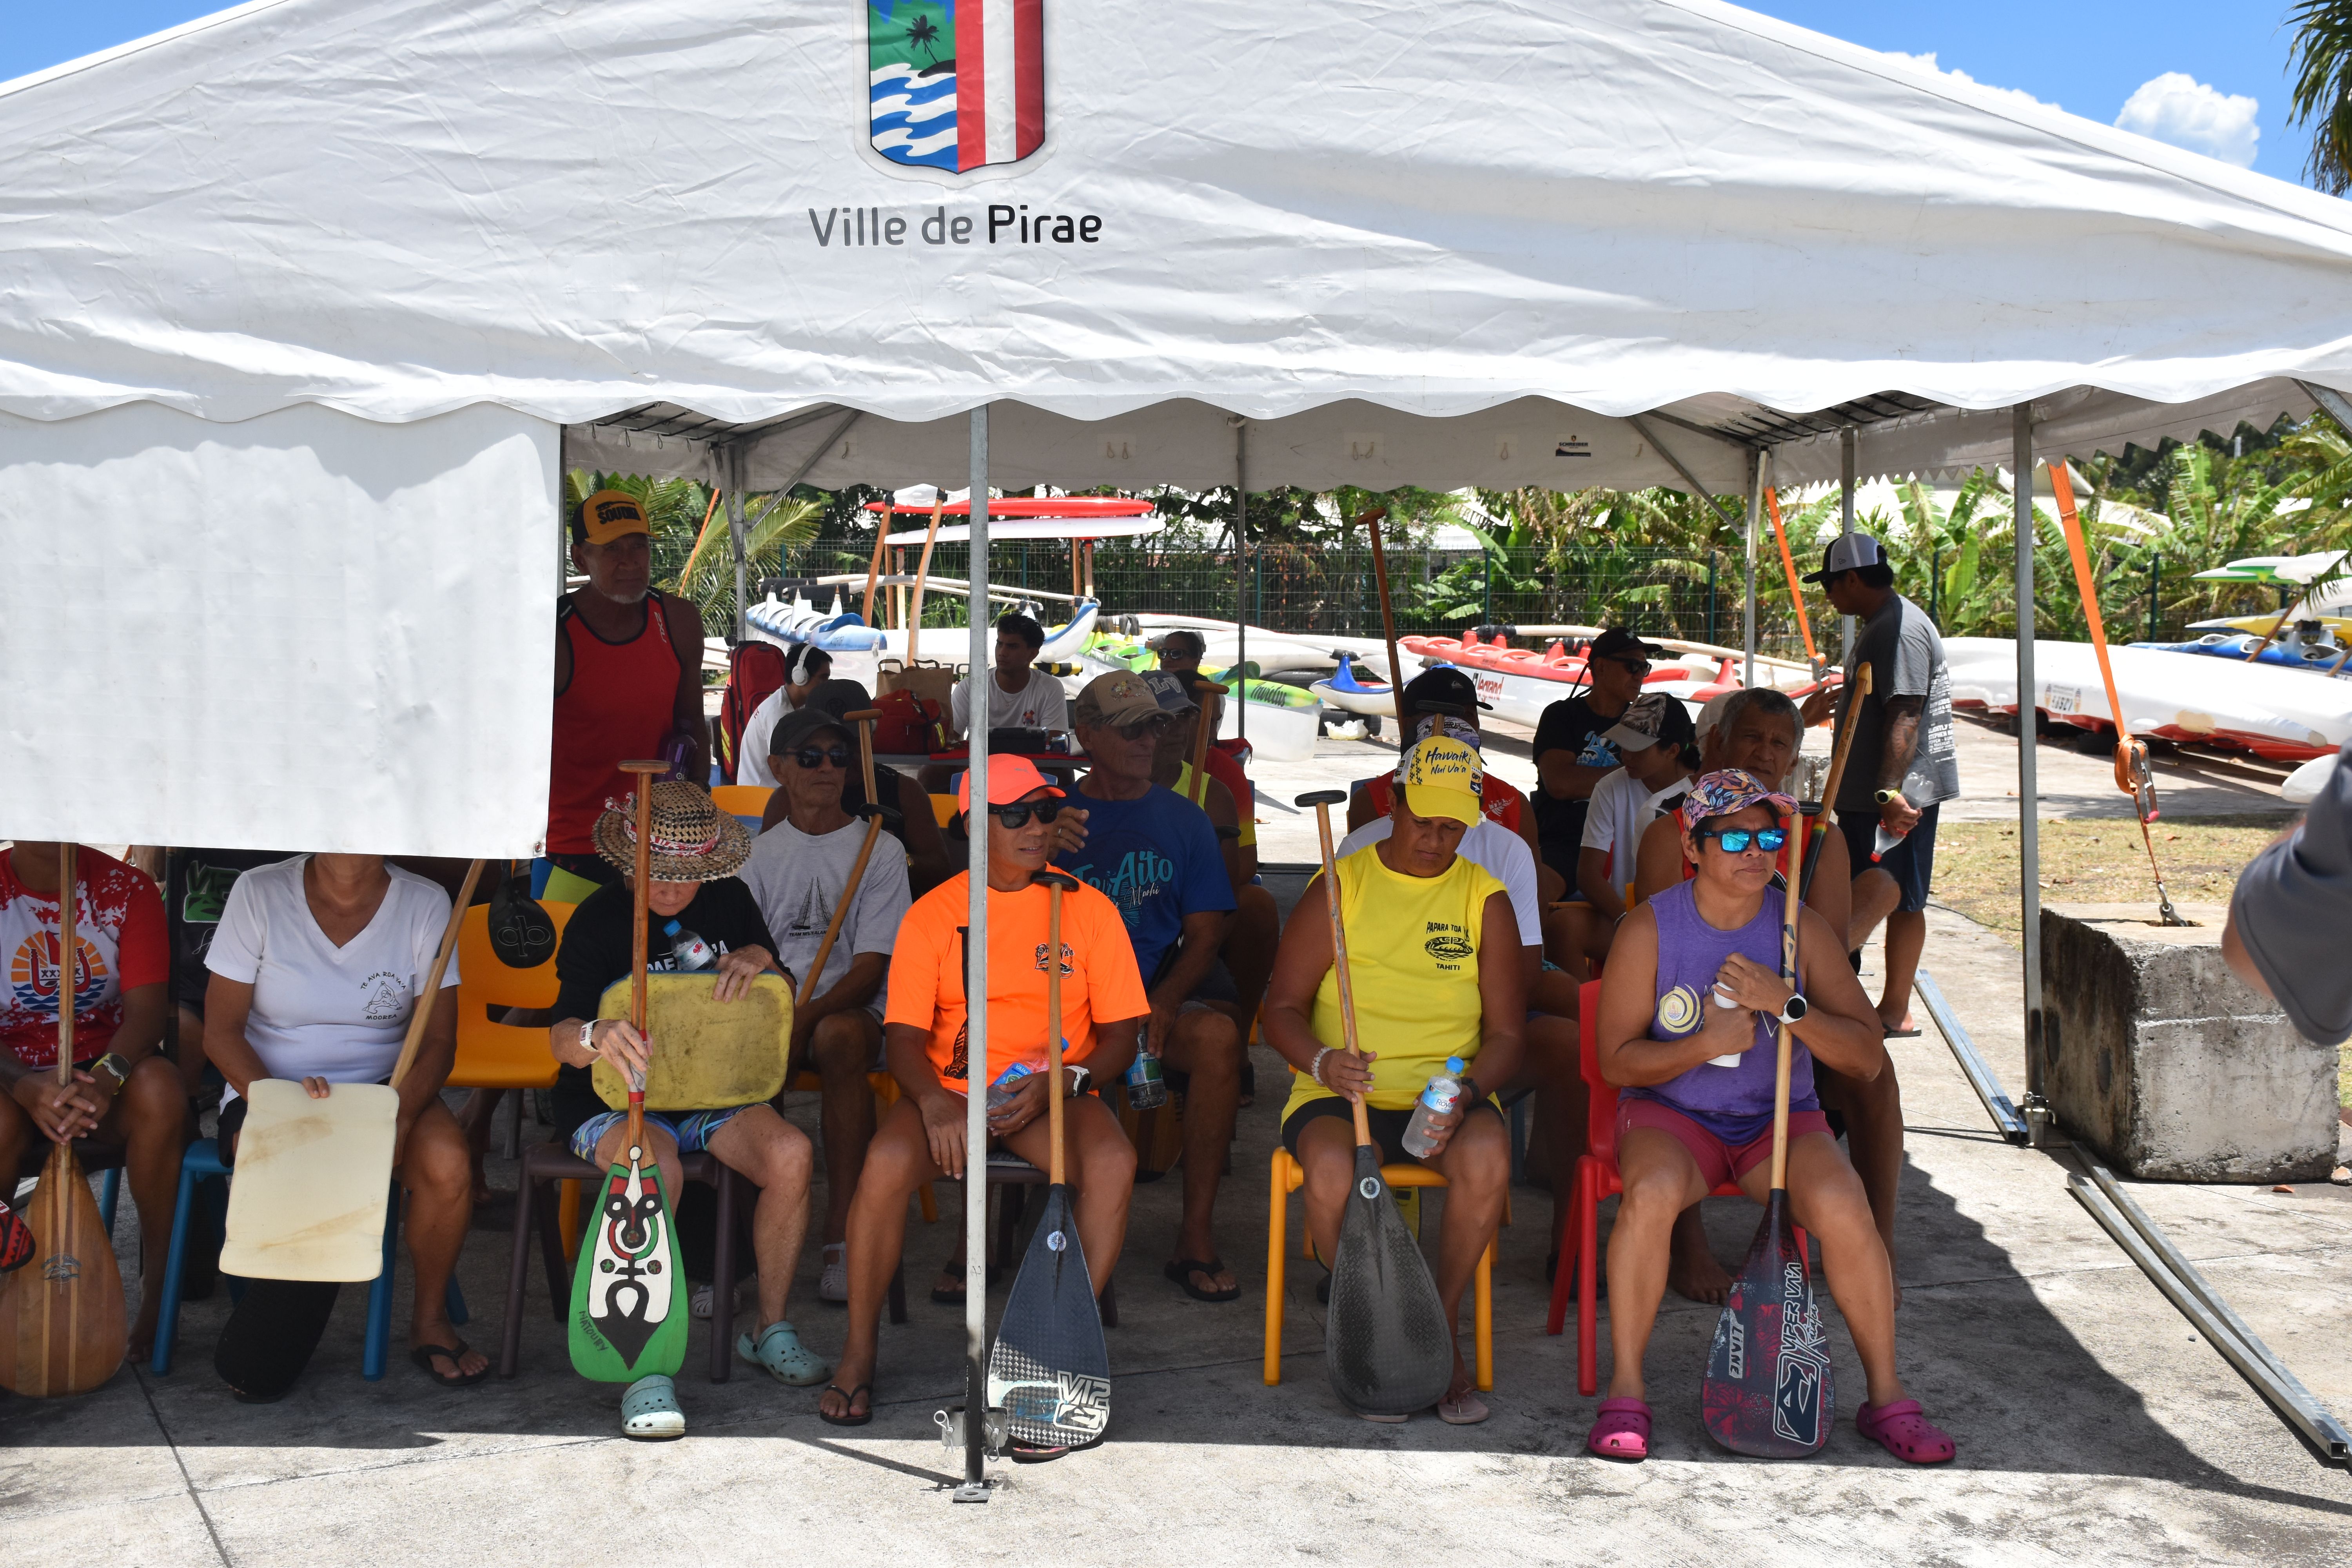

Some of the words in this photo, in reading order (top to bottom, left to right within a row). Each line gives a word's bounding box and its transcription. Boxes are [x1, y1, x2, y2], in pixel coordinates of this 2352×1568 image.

[808, 207, 907, 247] Ville
[921, 206, 973, 245] de
[989, 205, 1102, 243] Pirae
[1148, 677, 1181, 694] LV
[1426, 747, 1471, 764] Hawaiki
[1430, 765, 1446, 775] Nui
[1448, 763, 1466, 773] Va'a
[1109, 851, 1173, 897] Aito
[1426, 921, 1448, 934] PAPARA
[1450, 924, 1461, 933] TOA
[368, 973, 381, 982] AVA
[579, 1310, 609, 1351] MATOURY
[1781, 1300, 1800, 1351] VIPER
